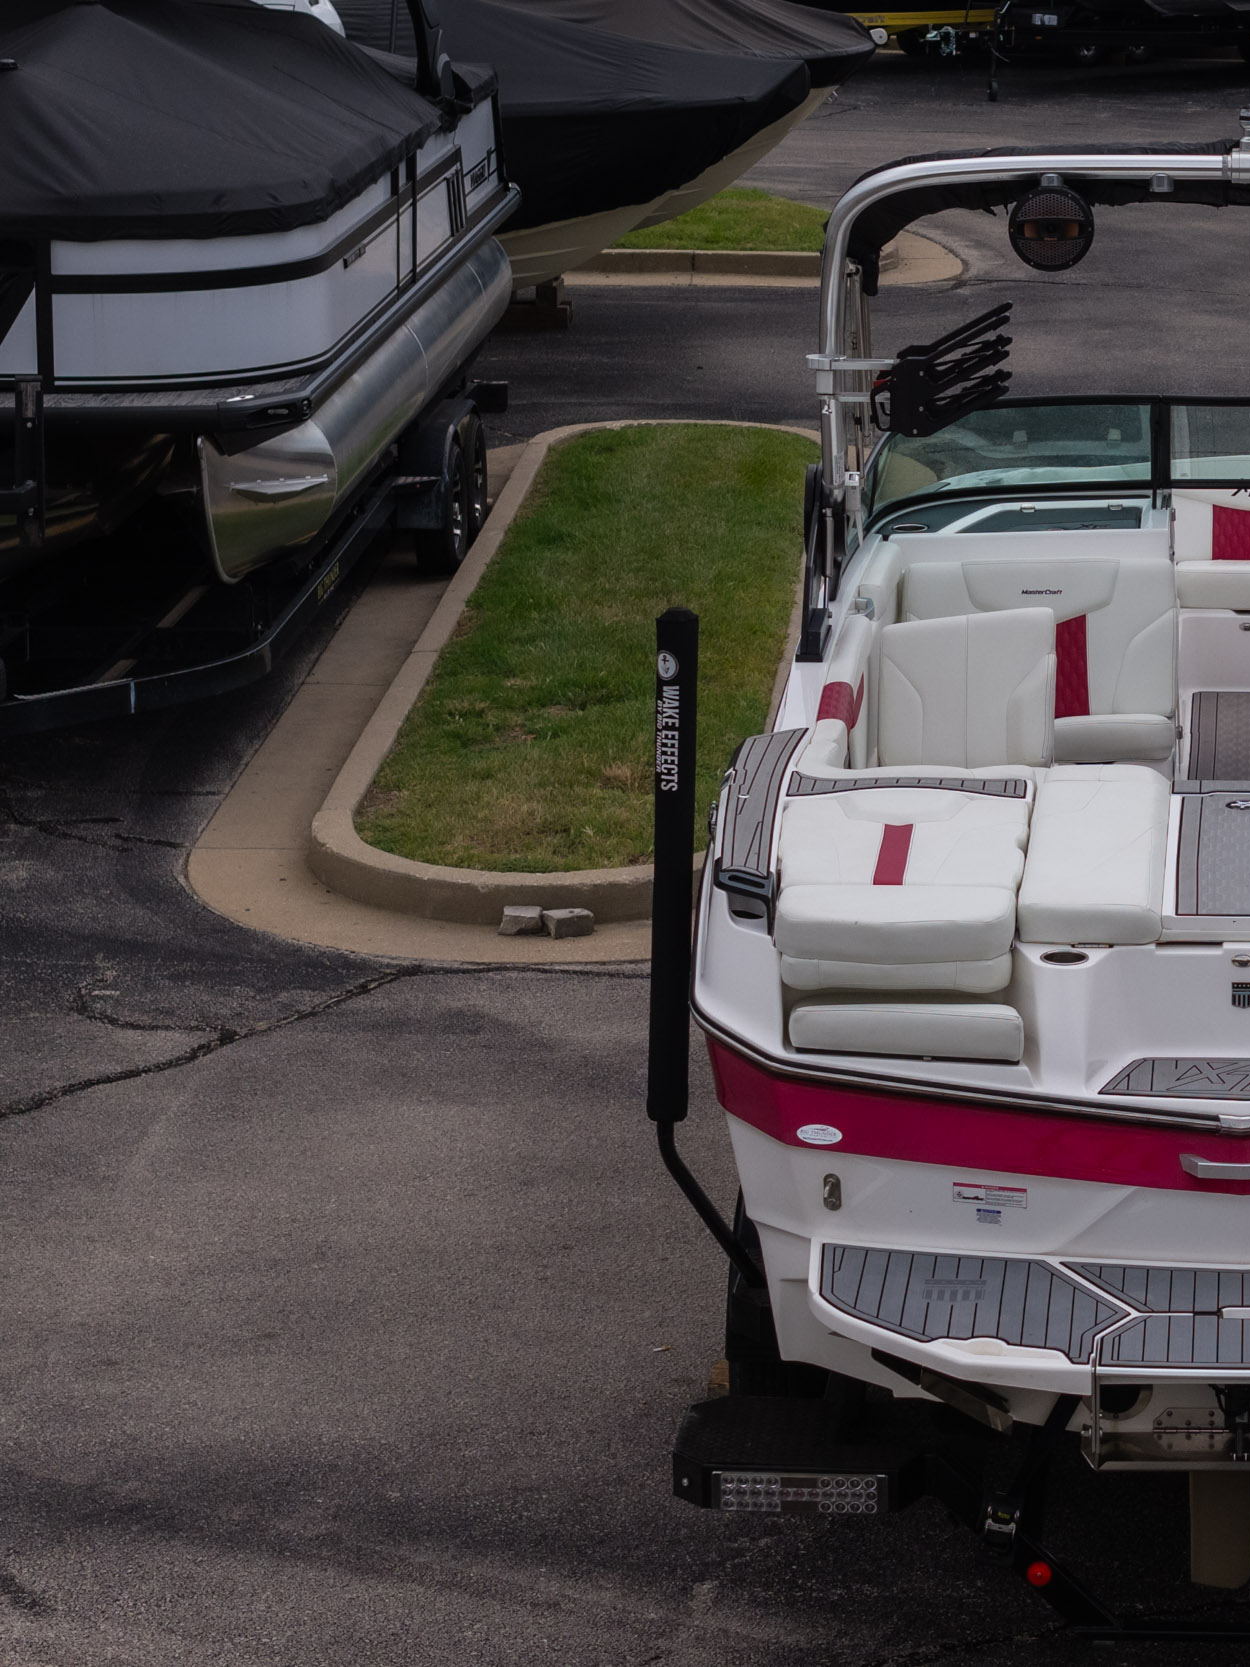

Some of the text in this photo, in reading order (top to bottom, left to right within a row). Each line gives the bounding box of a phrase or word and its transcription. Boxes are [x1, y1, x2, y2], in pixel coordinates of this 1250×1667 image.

[657, 700, 664, 713] BY
[655, 731, 663, 773] THUNDER
[660, 685, 680, 792] WAKE EFFECTS
